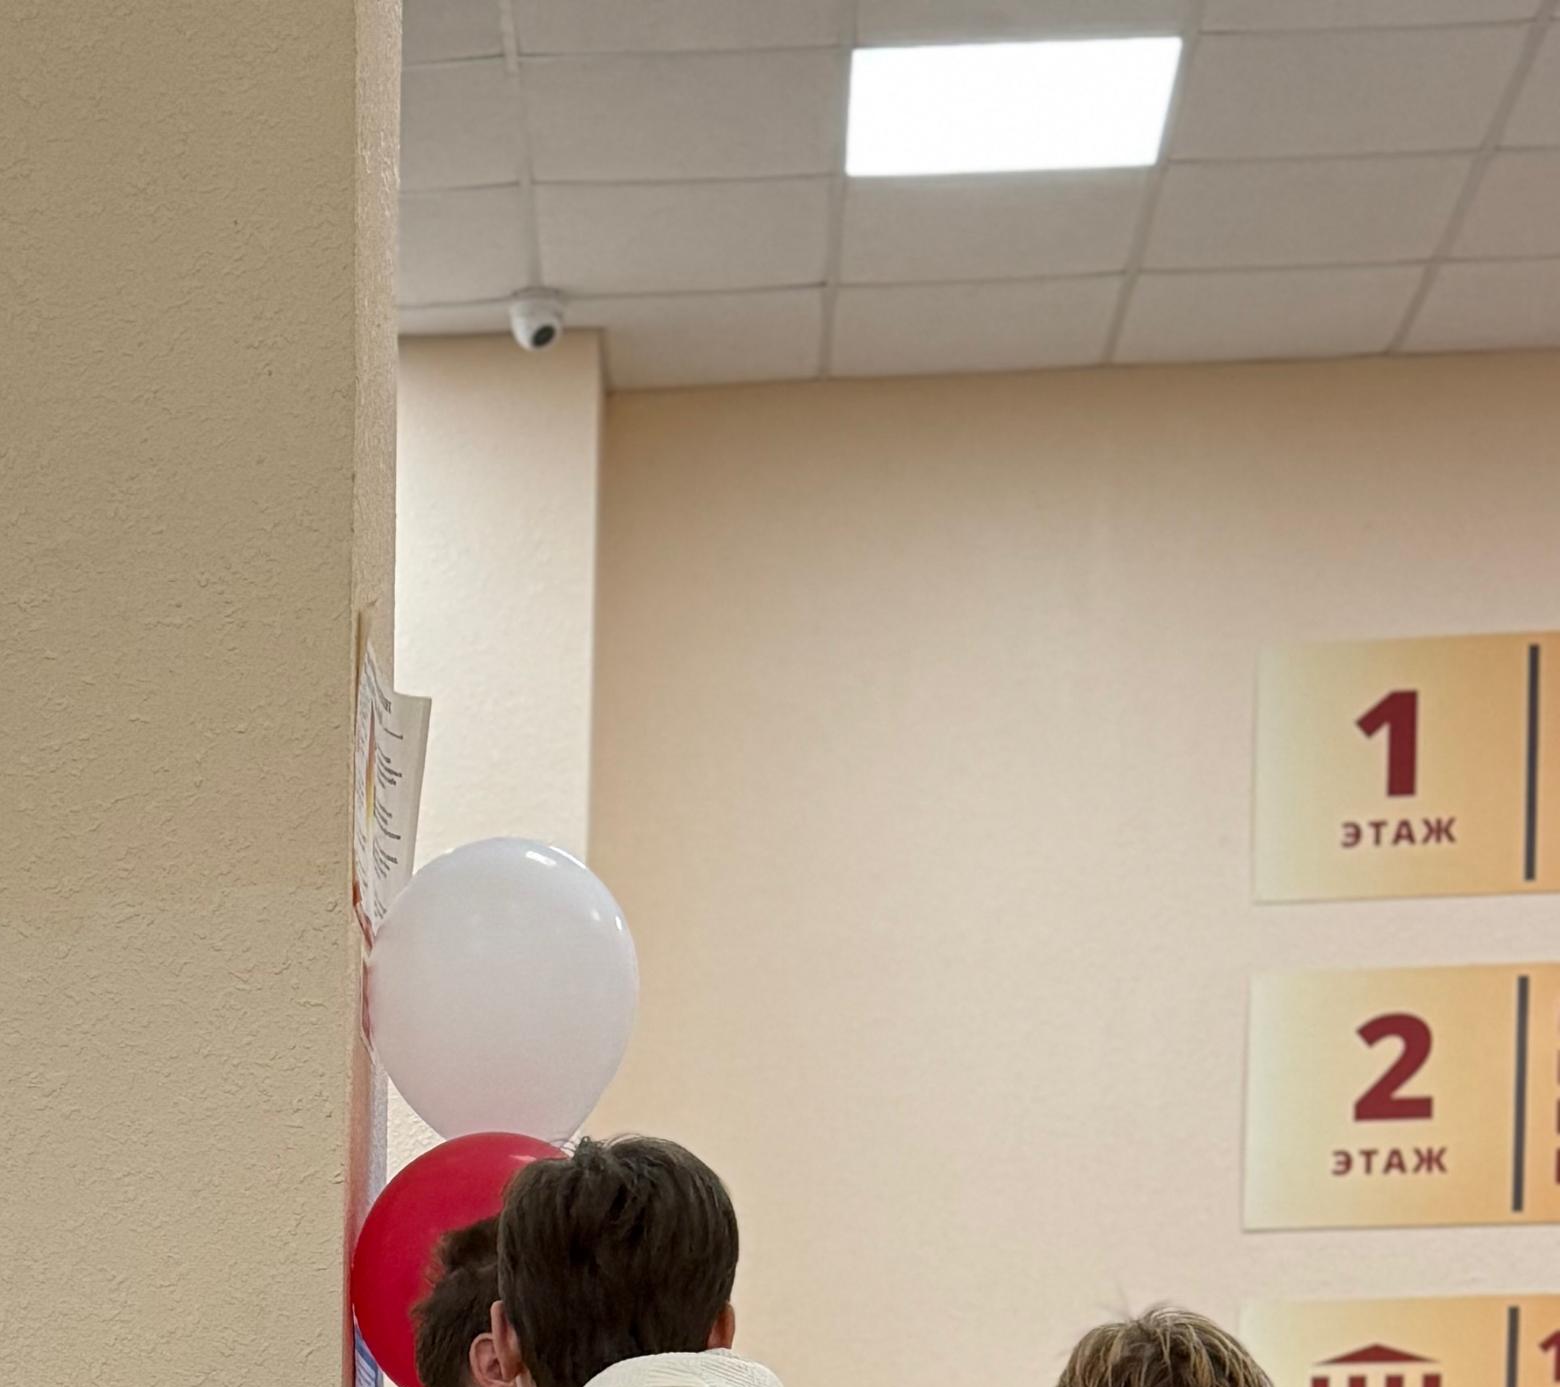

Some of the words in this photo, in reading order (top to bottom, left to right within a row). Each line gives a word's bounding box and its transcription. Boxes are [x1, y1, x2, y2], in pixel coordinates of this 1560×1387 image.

[1355, 689, 1418, 797] 1
[1341, 816, 1456, 848] ЭТАЖ
[1354, 1012, 1433, 1122] 2
[1331, 1147, 1448, 1177] ЭТАЖ
